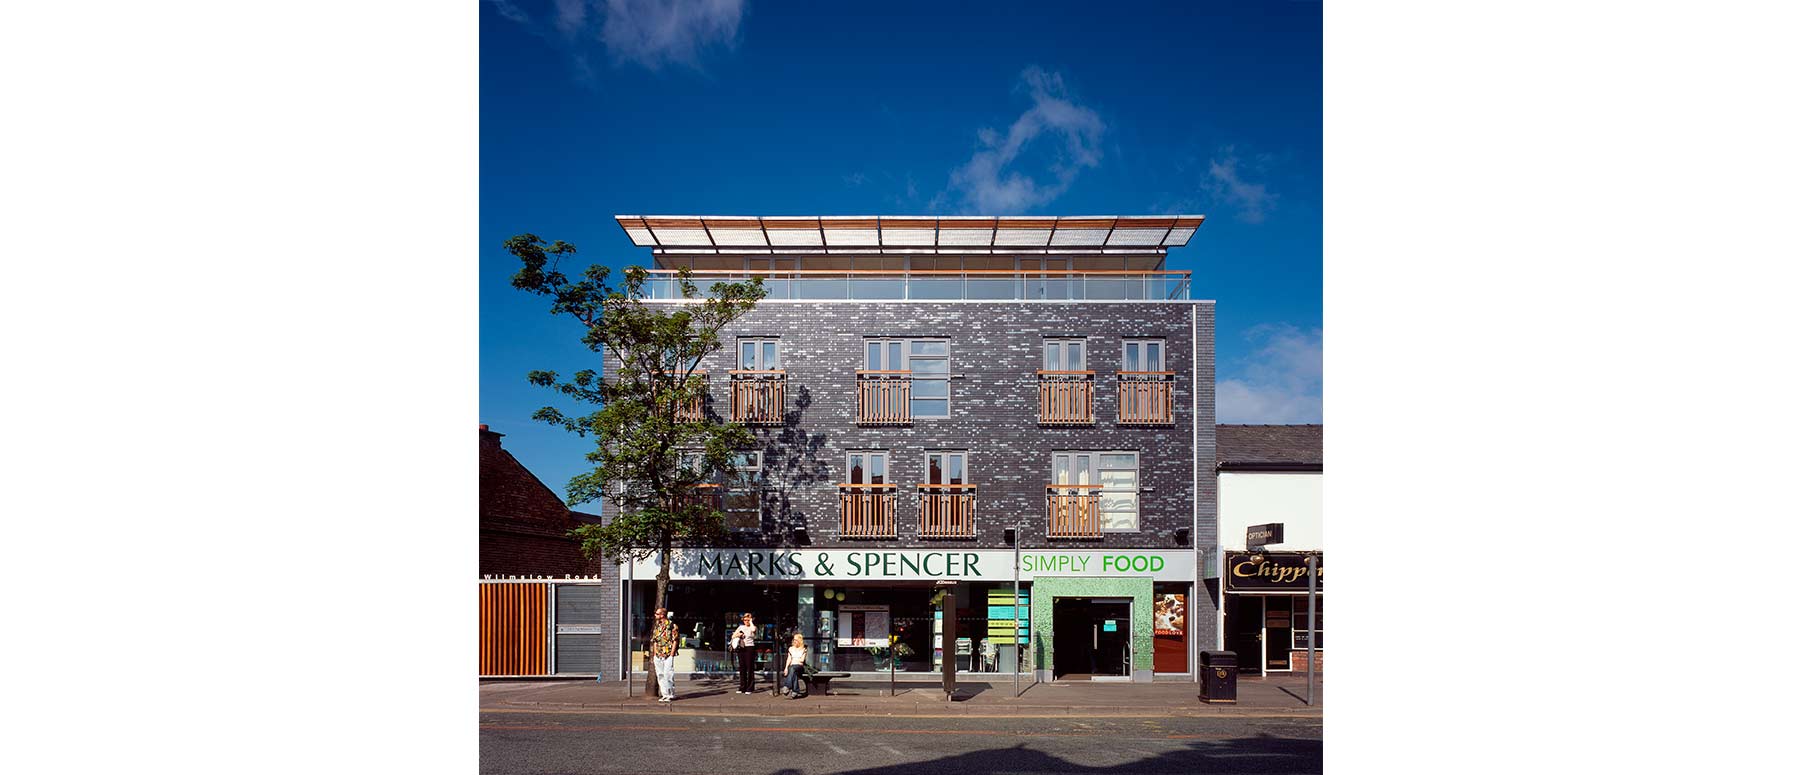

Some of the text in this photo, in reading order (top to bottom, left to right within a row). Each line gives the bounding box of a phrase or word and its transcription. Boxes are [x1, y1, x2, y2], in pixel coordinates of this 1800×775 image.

[1248, 530, 1273, 540] OPTICIAN
[698, 552, 983, 576] MARKS & SPENCER
[1022, 555, 1165, 572] SIMPLY FOOD
